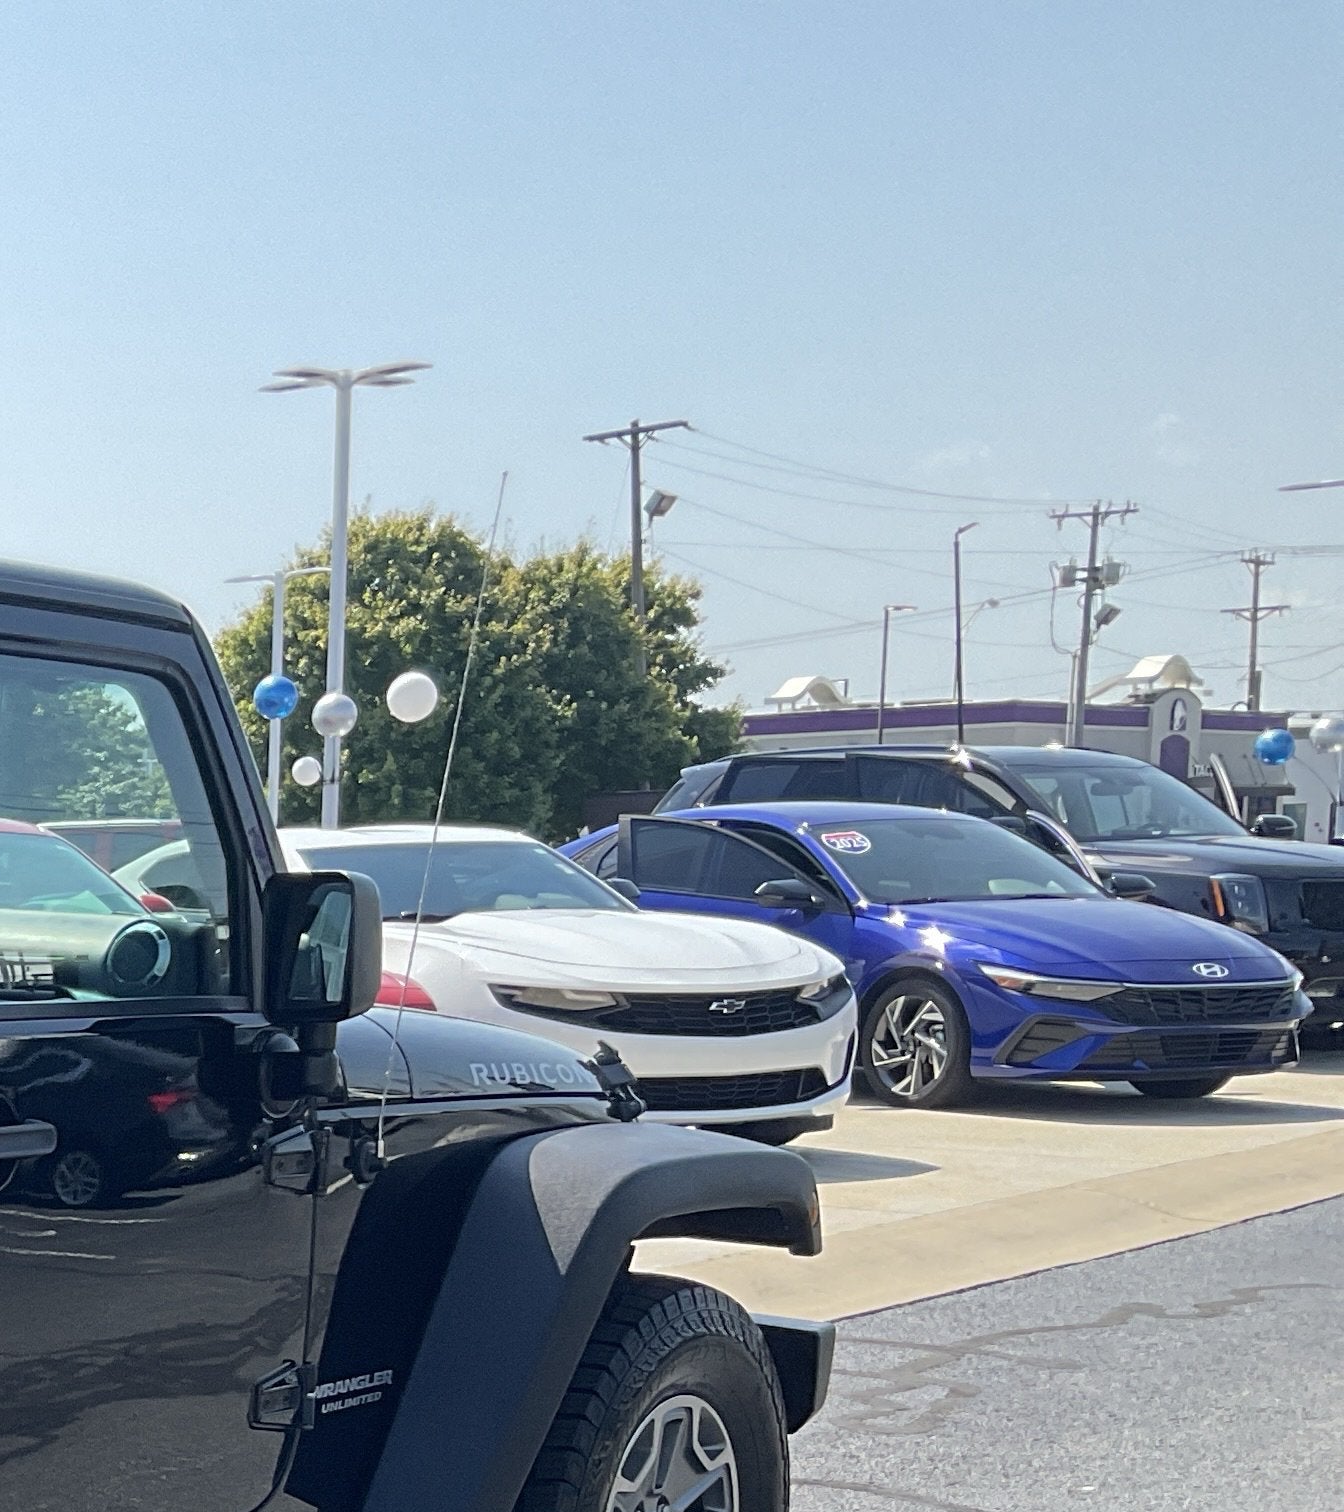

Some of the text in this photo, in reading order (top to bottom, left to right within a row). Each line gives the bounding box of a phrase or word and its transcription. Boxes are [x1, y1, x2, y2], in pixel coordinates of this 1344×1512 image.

[828, 835, 869, 851] 2025
[469, 1061, 595, 1087] RUBICON
[310, 1369, 393, 1399] WRANGLER
[321, 1391, 382, 1415] UNLIMITED
